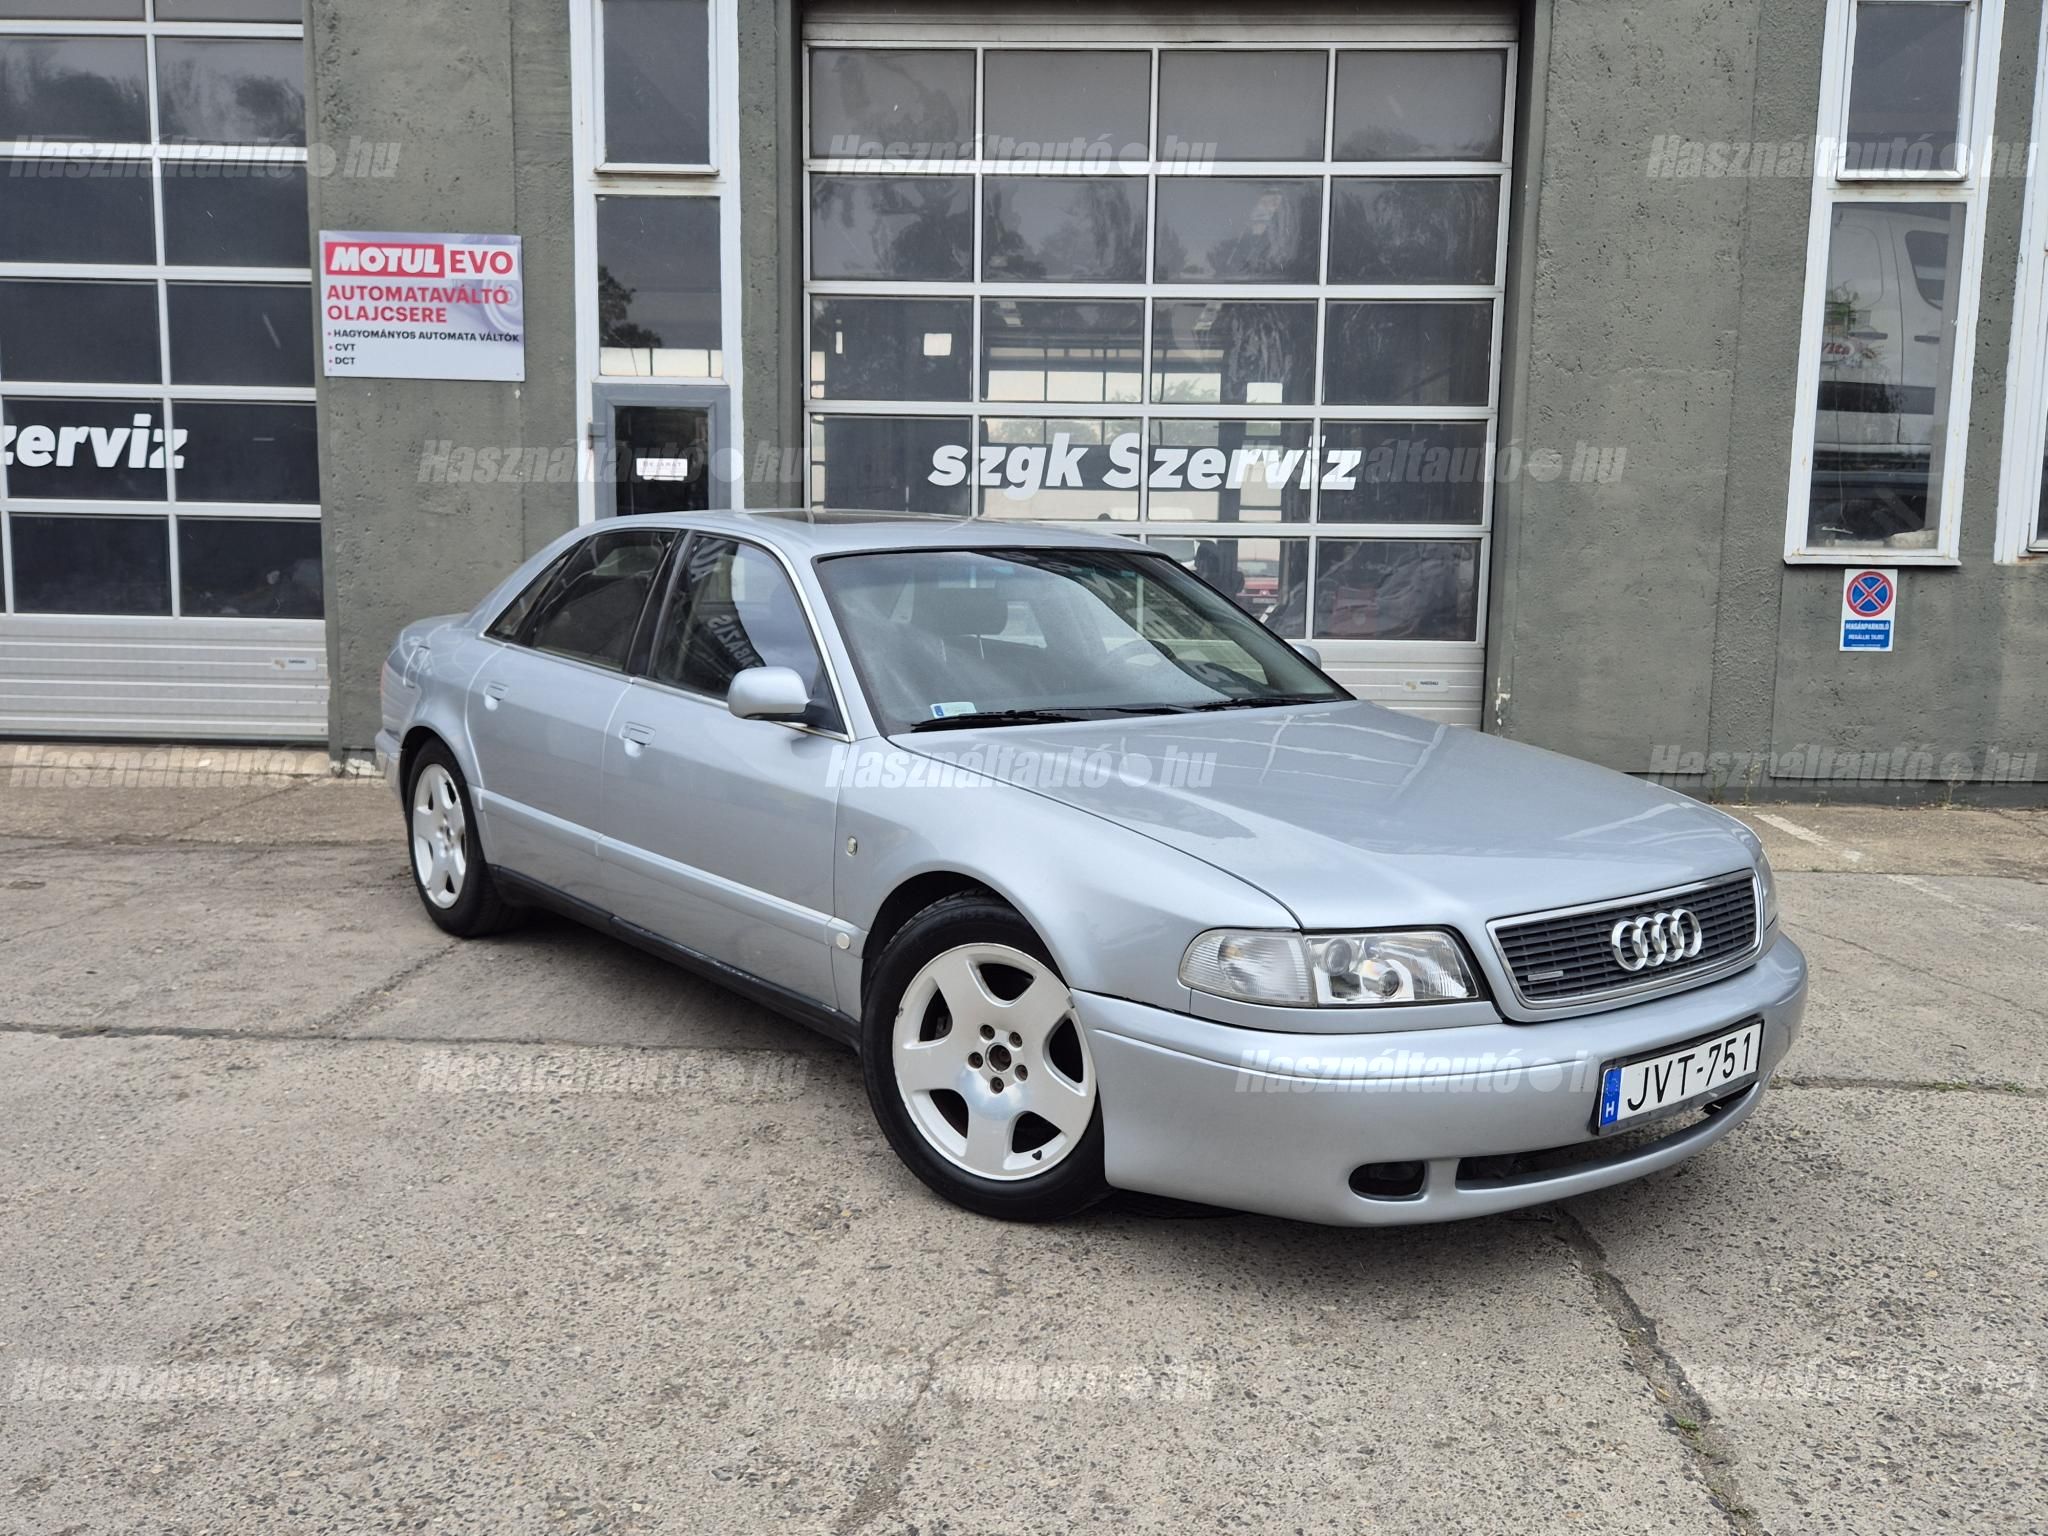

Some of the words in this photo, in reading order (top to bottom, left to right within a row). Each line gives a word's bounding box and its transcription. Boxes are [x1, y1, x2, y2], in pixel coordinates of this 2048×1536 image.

[330, 246, 440, 273] MOTUL
[450, 250, 513, 274] EVO
[327, 285, 509, 304] AUTOMATAVÁLTÓ
[327, 305, 447, 323] OLAJCSERE
[333, 328, 416, 340] HAGYOMÁNYOS
[418, 331, 477, 341] AUTOMATA
[479, 331, 519, 342] VÁLTÓK
[335, 343, 356, 351] CVT
[335, 356, 356, 365] DCT
[928, 432, 1088, 500] szgk
[1102, 432, 1362, 491] Szerviz
[1627, 1032, 1751, 1111] JVT-751
[1605, 1101, 1615, 1118] H
